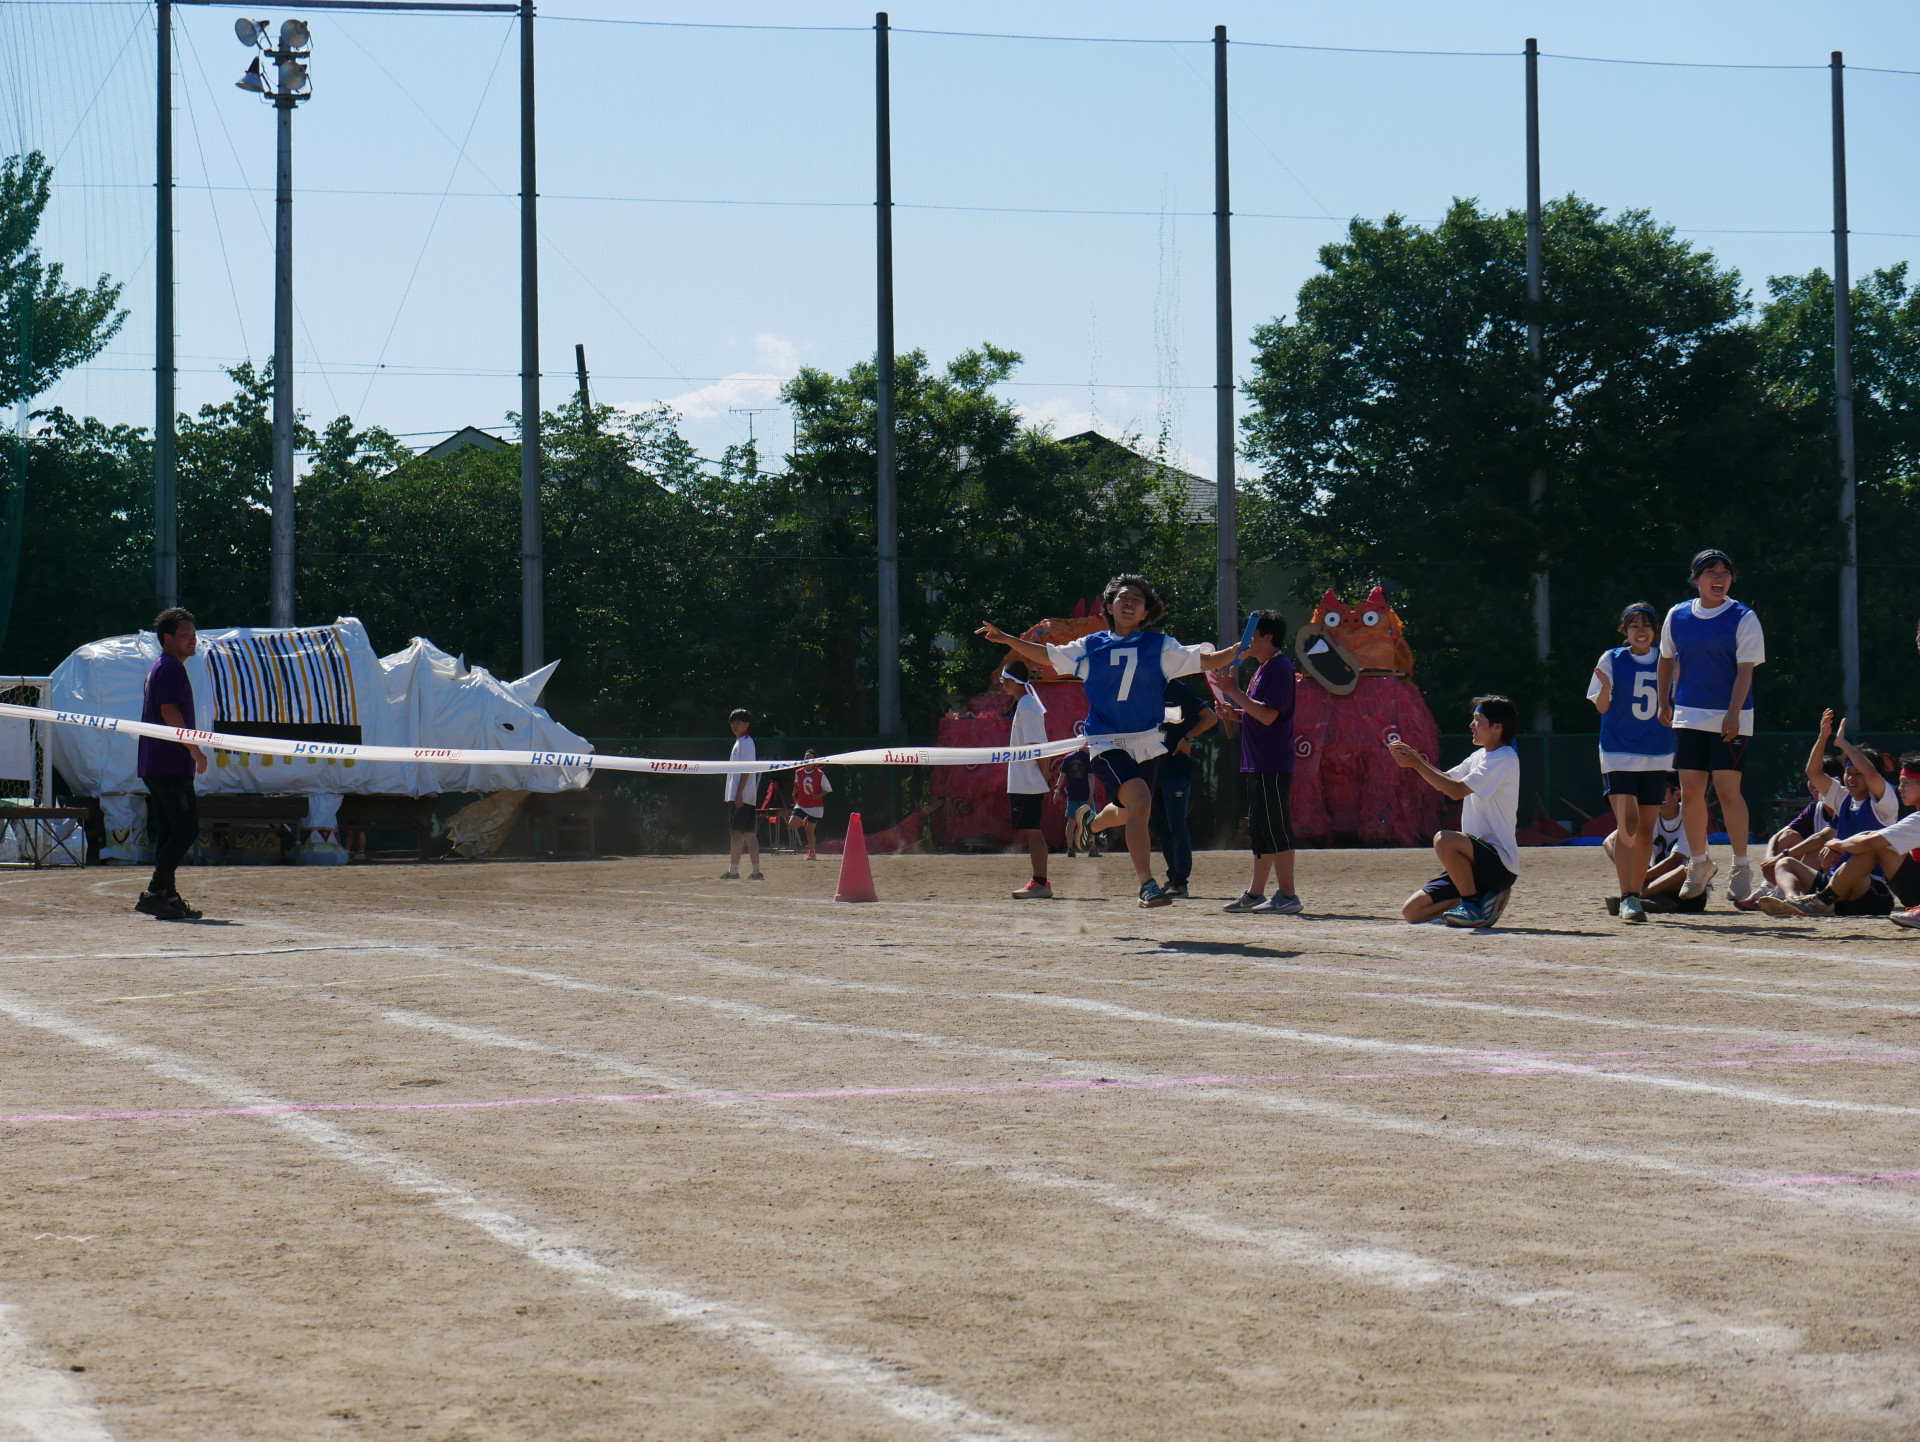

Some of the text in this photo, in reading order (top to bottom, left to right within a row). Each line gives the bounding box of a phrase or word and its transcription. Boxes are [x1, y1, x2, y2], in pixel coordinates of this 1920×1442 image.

[1110, 647, 1138, 701] 7
[1631, 671, 1658, 720] 5
[57, 712, 118, 730] FINISH
[531, 752, 593, 767] FINISH
[802, 776, 814, 795] 6
